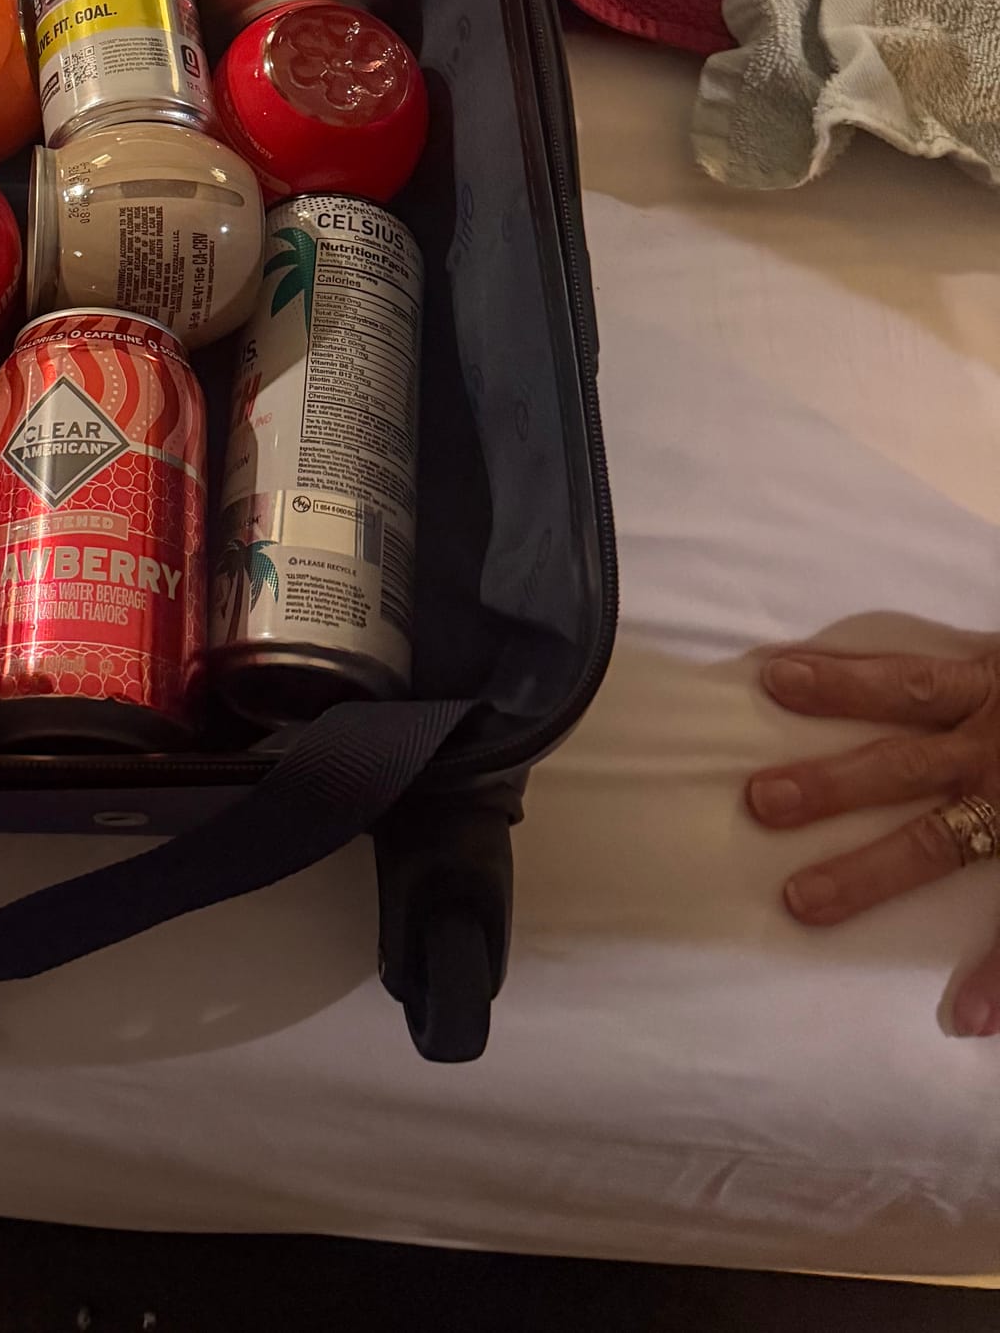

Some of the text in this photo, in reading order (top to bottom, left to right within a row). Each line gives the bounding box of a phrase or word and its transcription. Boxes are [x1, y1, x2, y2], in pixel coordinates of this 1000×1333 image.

[54, 17, 73, 38] FIT.
[75, 3, 118, 25] GOAL.
[316, 212, 404, 251] CELSIUS
[192, 232, 208, 265] CA-CRV
[320, 241, 410, 280] Nutrition Facts
[317, 274, 361, 289] Calories
[83, 330, 144, 347] CAFFEINE
[312, 334, 340, 343] Vitamin
[311, 350, 335, 359] Niacin
[310, 359, 338, 368] Vitamin
[310, 367, 337, 376] Vitamin
[309, 376, 331, 385] Biotin
[23, 420, 102, 444] CLEAR
[298, 558, 325, 570] PLEASE
[58, 582, 95, 602] WATER
[95, 584, 148, 611] BEVERAGE
[82, 602, 130, 627] FLAVORS
